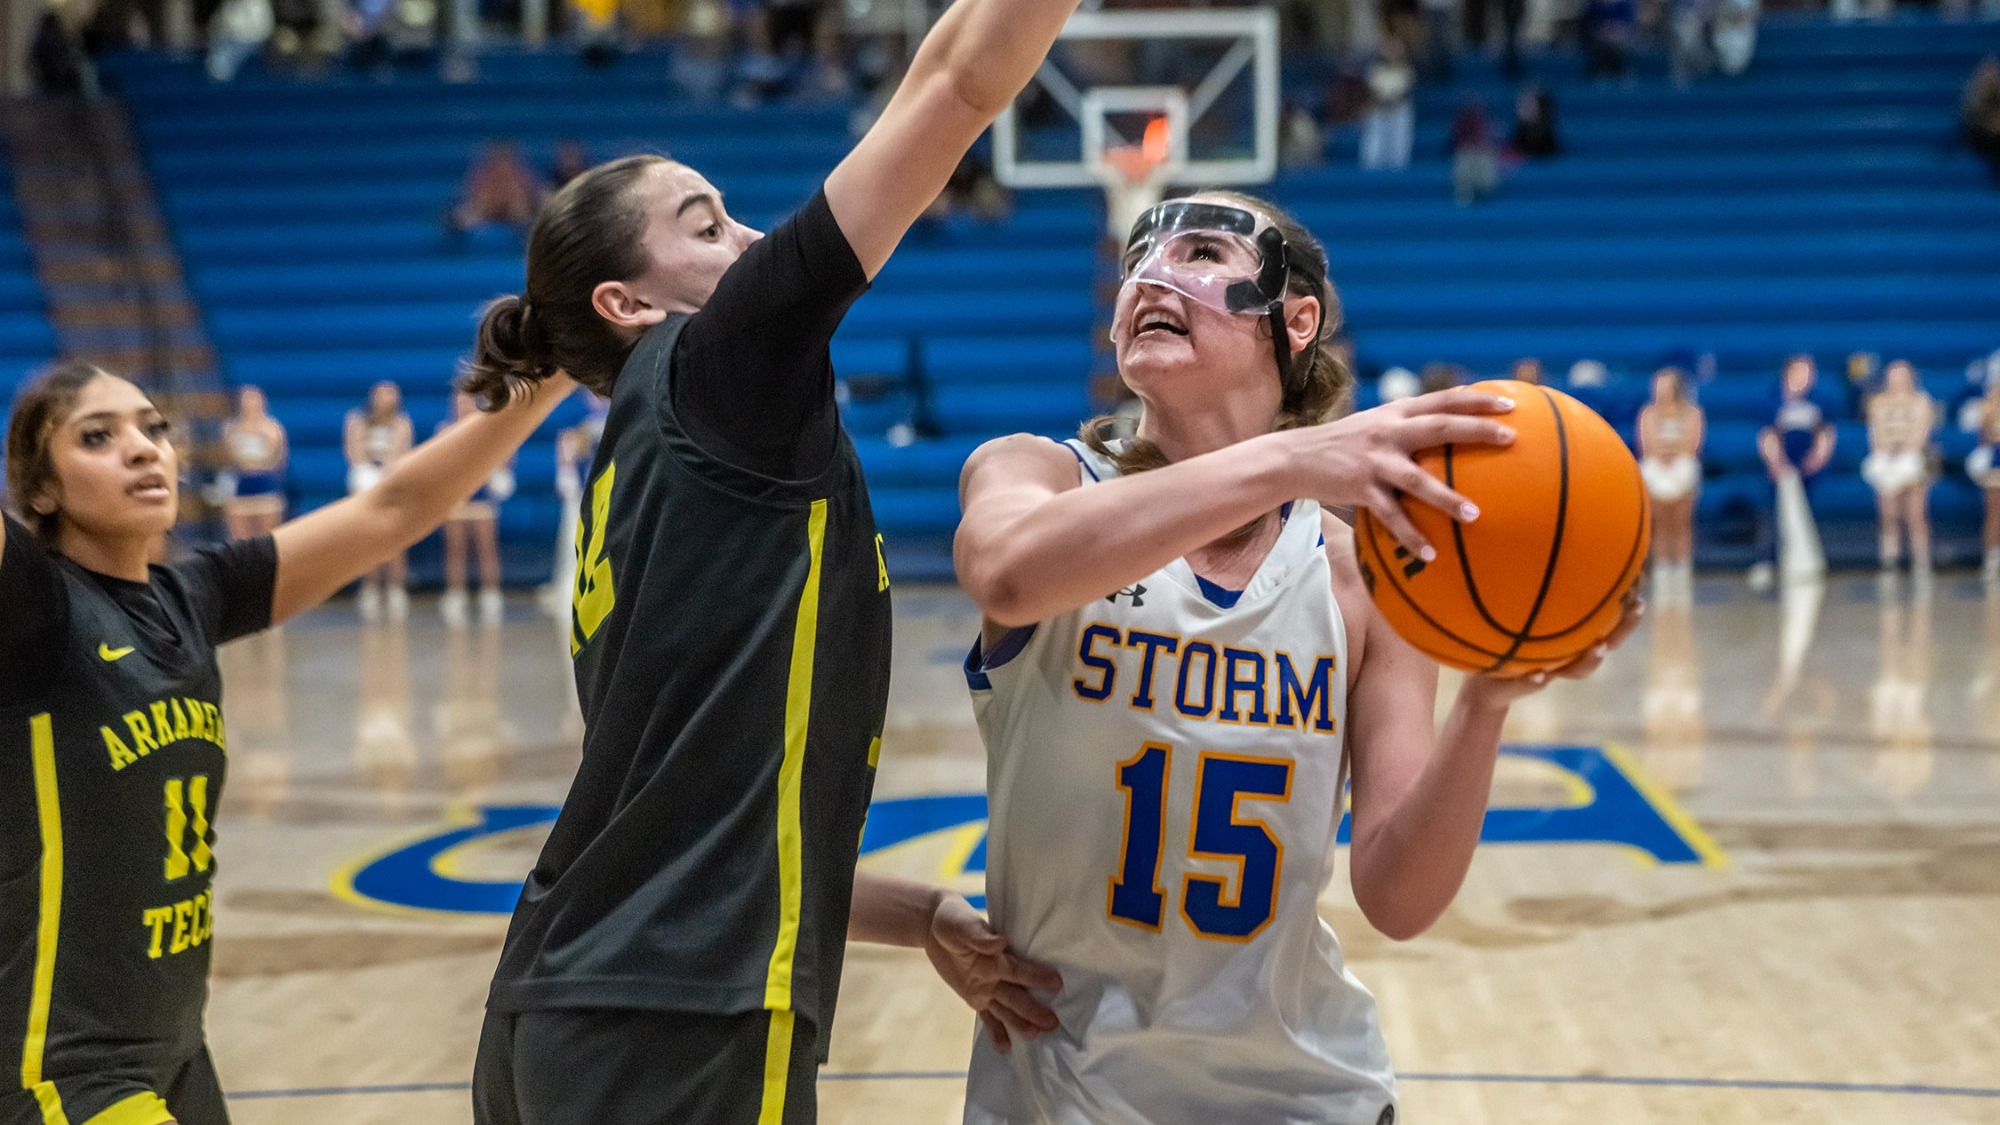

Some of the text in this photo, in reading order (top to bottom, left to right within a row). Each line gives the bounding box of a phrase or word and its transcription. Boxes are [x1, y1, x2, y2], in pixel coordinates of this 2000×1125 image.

[1072, 621, 1337, 735] STORM
[164, 775, 213, 881] 11
[1106, 740, 1297, 944] 15
